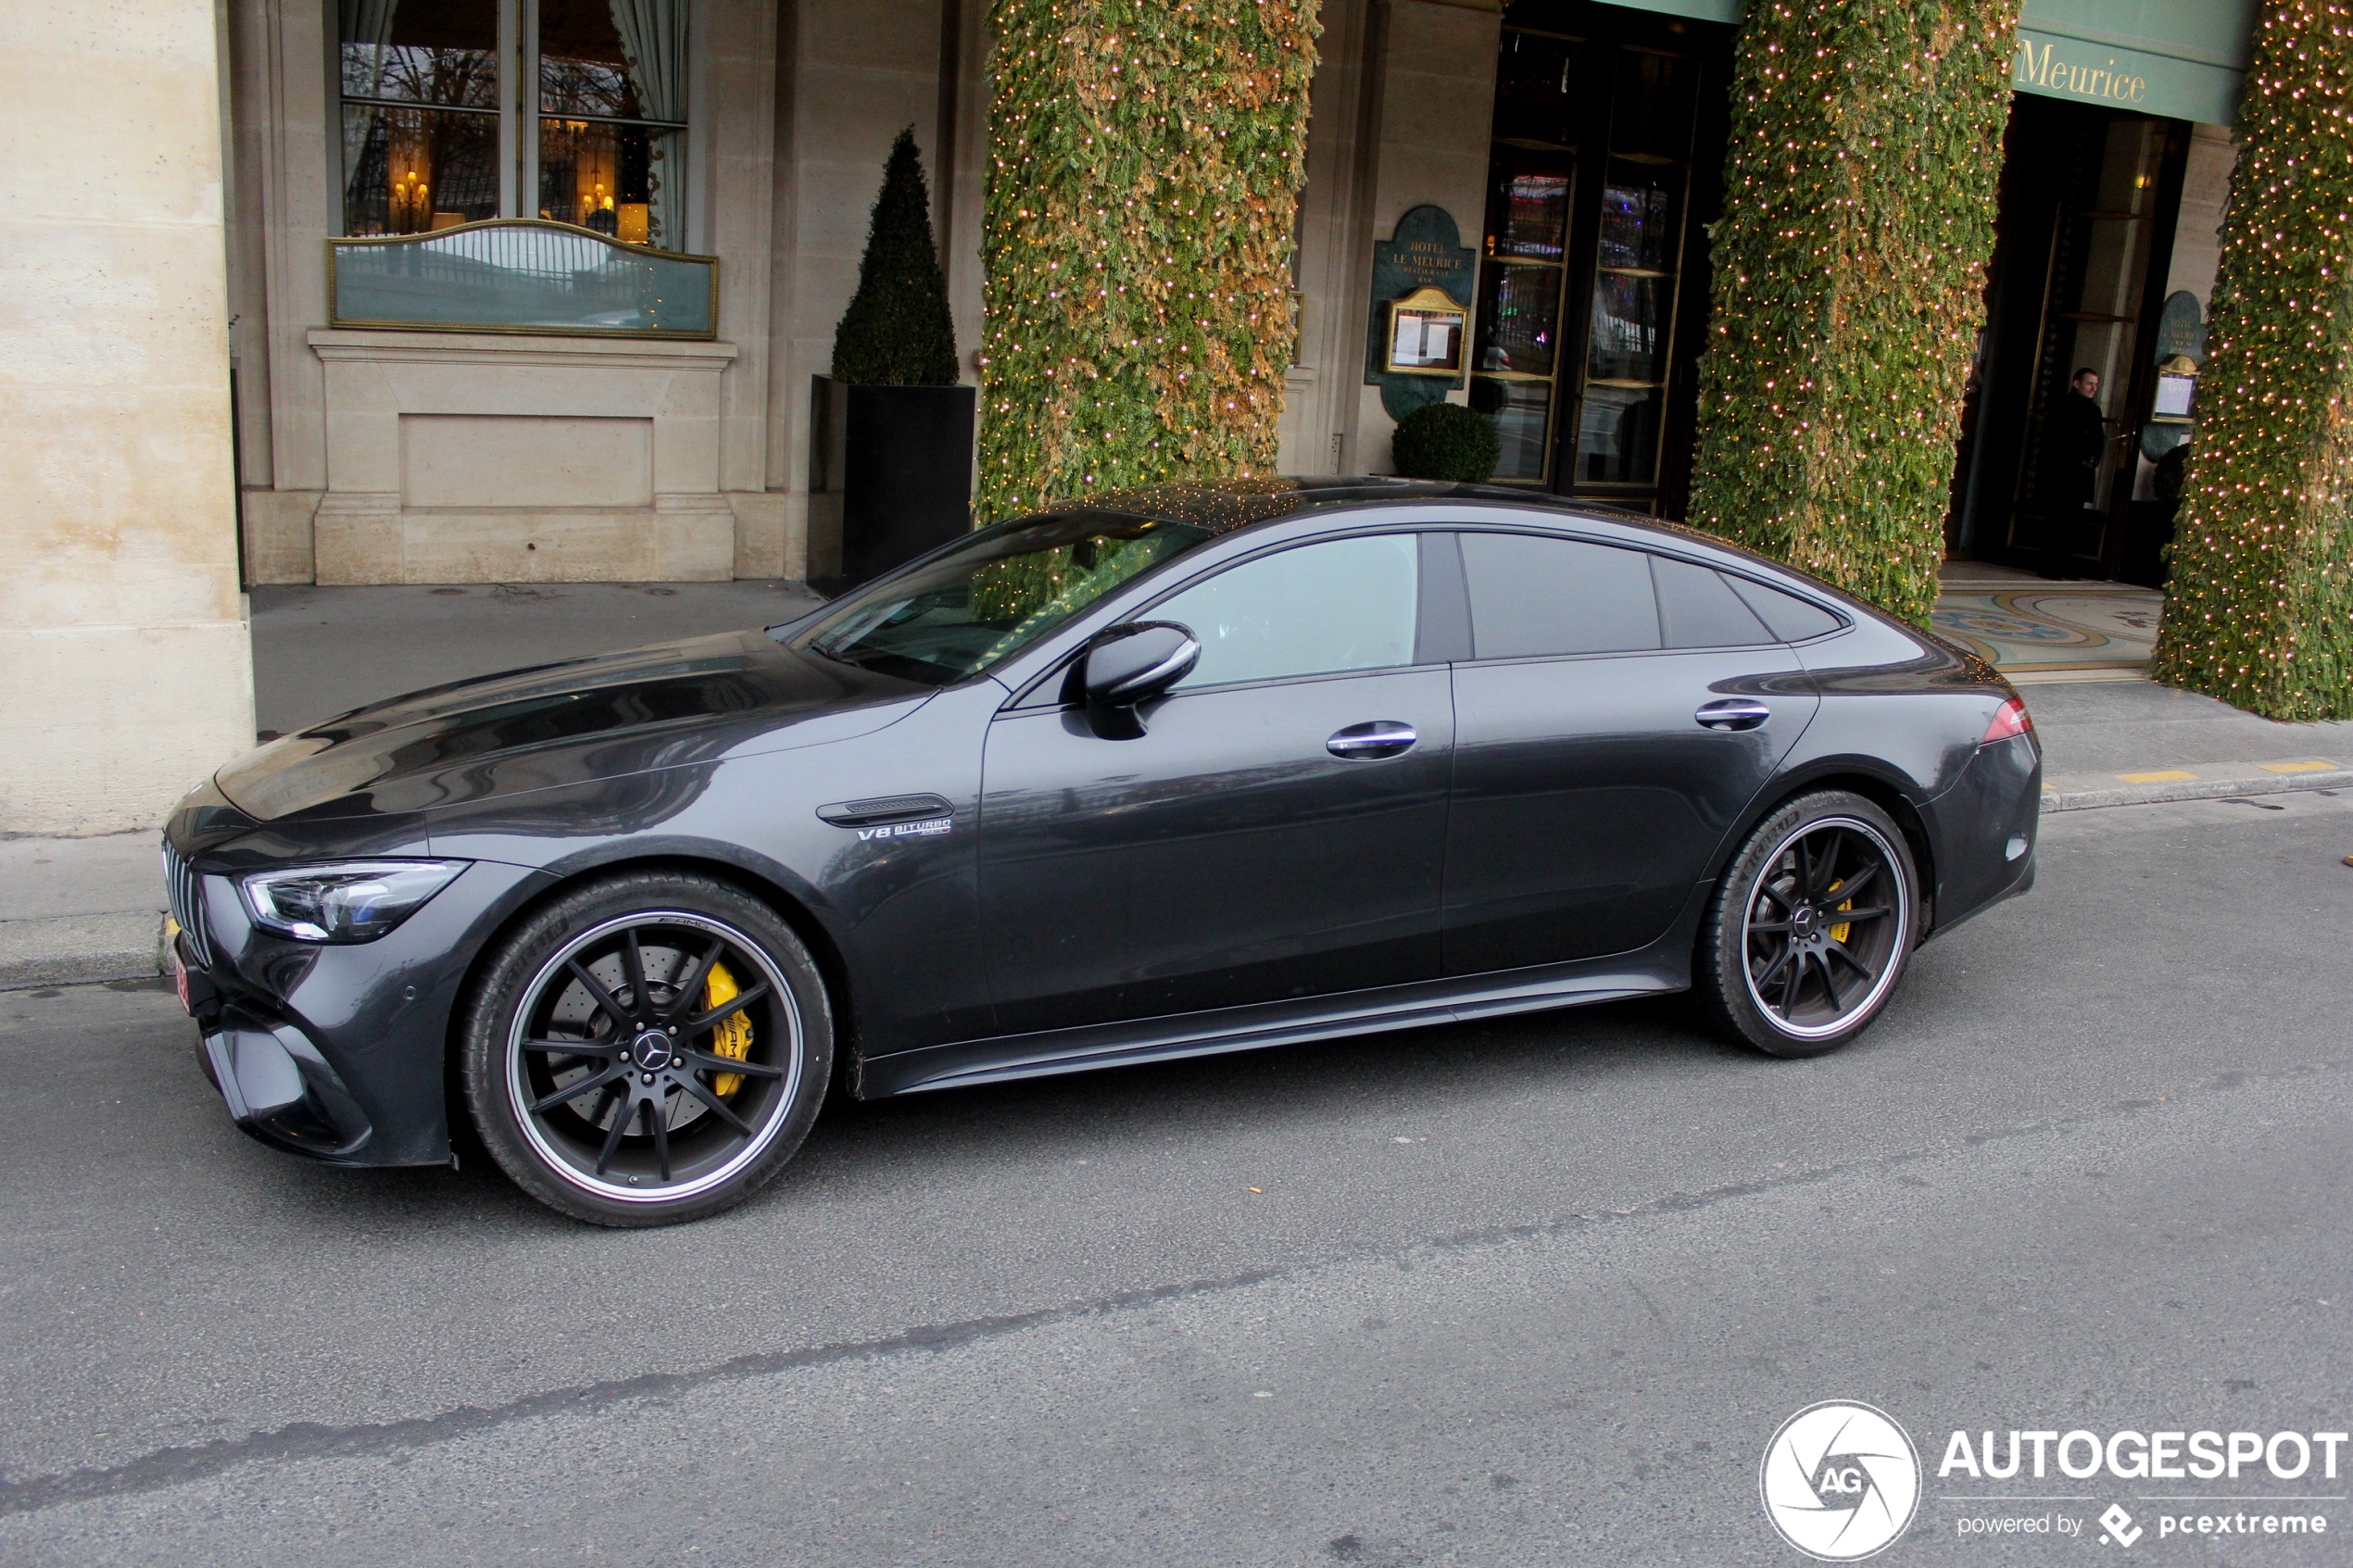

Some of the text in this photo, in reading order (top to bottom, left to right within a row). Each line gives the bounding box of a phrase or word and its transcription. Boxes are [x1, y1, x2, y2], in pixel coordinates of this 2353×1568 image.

[2017, 39, 2146, 103] Meurice
[1411, 242, 1447, 254] HOTEL
[1393, 254, 1462, 270] LE MEURICE
[1403, 267, 1450, 276] RESTAURANT
[857, 819, 951, 841] V8 BITURBO
[674, 918, 709, 930] AMG
